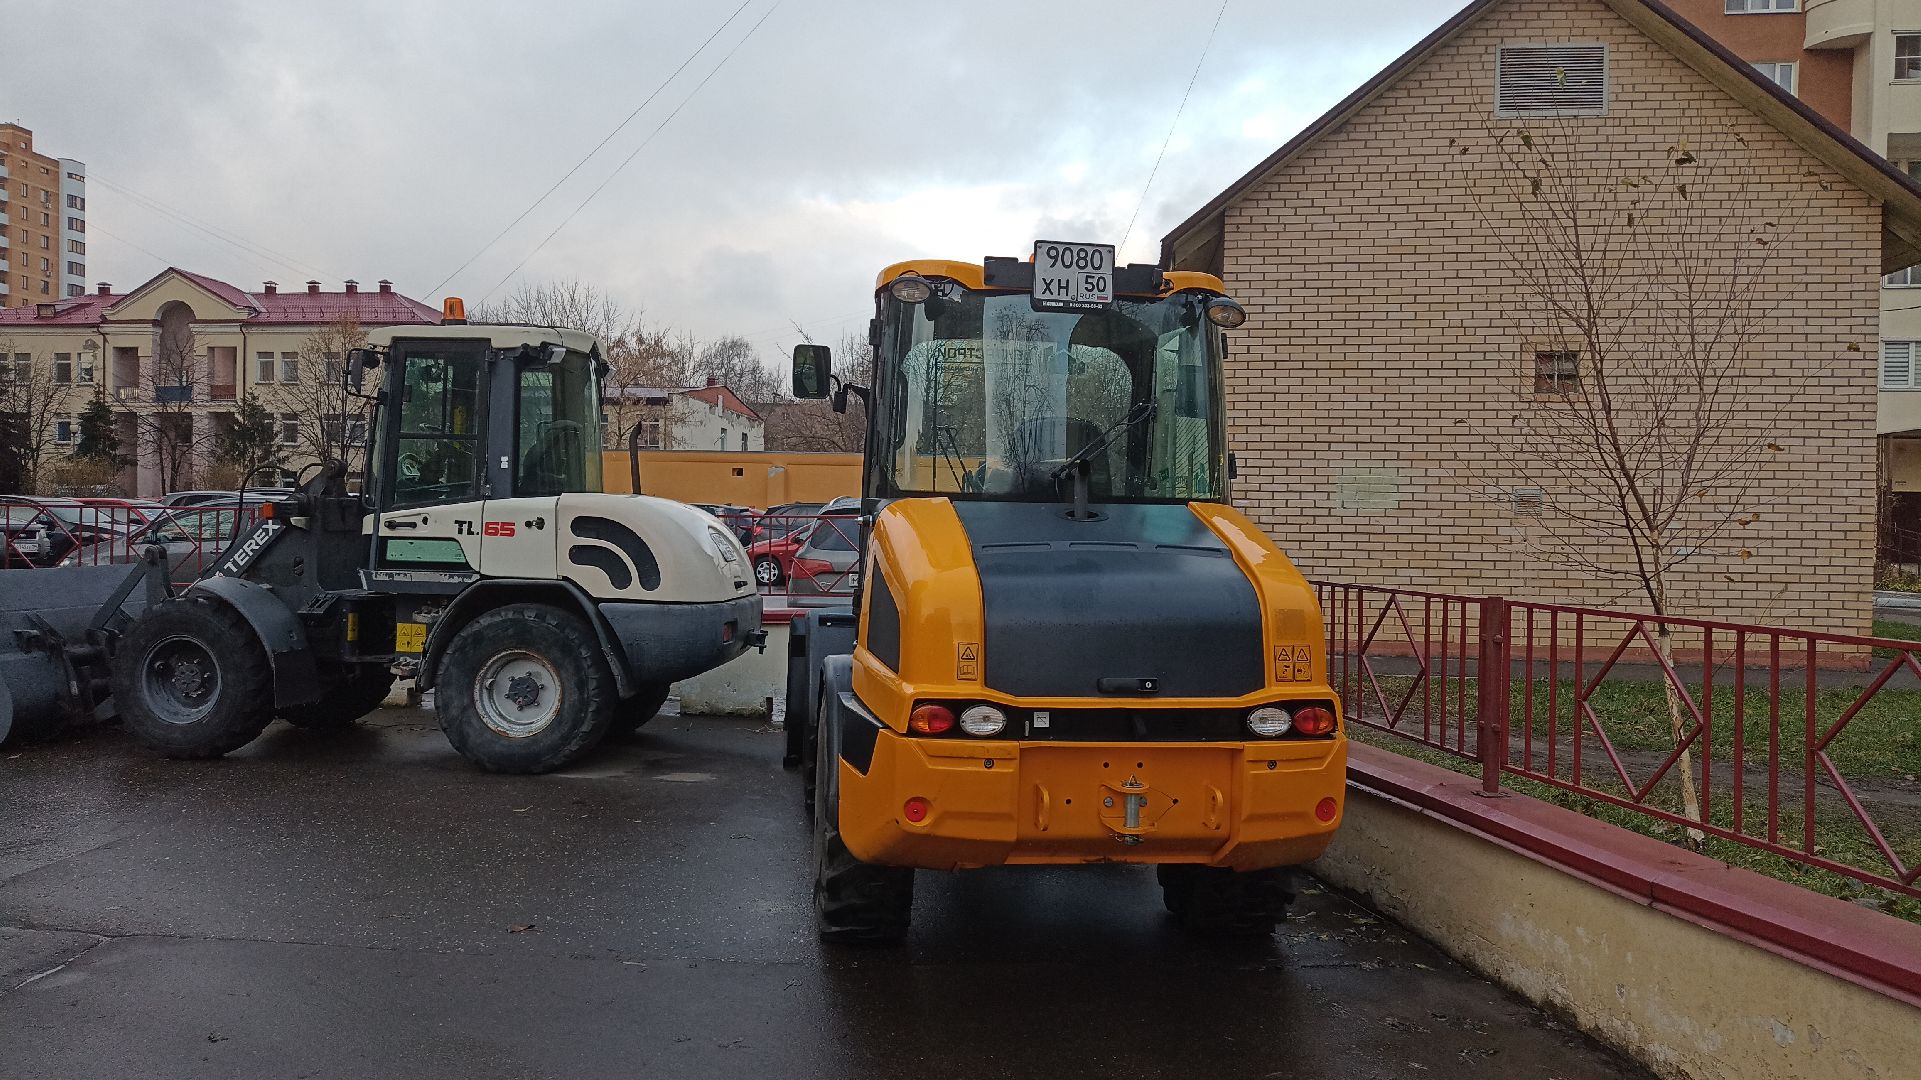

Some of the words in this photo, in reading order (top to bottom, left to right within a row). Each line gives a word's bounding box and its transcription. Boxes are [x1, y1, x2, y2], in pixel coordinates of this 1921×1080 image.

[1046, 246, 1104, 271] 9080
[1042, 278, 1070, 297] ХН
[1084, 275, 1107, 292] 50
[223, 519, 281, 572] TEREX
